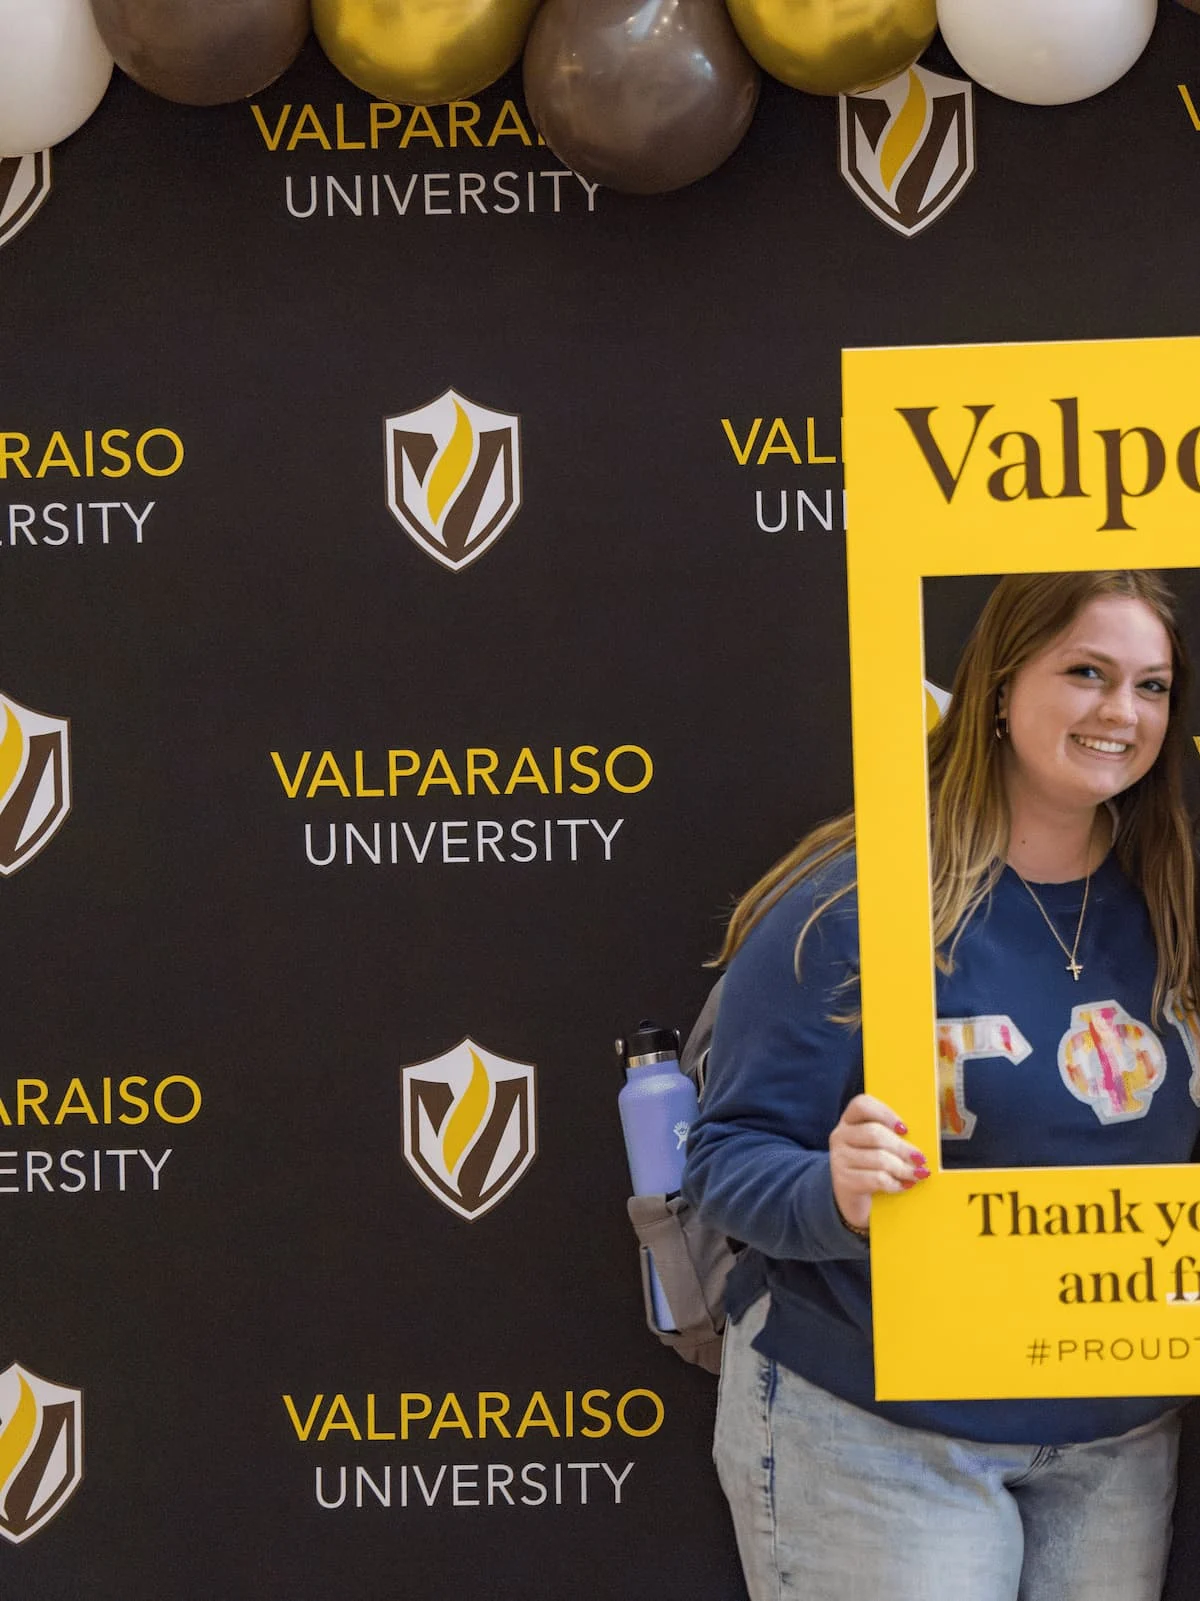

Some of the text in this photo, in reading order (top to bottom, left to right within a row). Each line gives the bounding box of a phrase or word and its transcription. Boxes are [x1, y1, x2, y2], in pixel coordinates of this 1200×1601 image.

[251, 99, 547, 151] VALPARA
[285, 170, 599, 218] UNIVERSITY
[0, 427, 185, 479] RAISO
[0, 501, 156, 546] RSITY
[270, 744, 654, 799] VALPARAISO
[304, 818, 625, 866] UNIVERSITY
[968, 1189, 1143, 1238] Thank
[1057, 1257, 1157, 1304] and
[282, 1388, 665, 1441] VALPARAISO
[315, 1462, 635, 1509] UNIVERSITY
